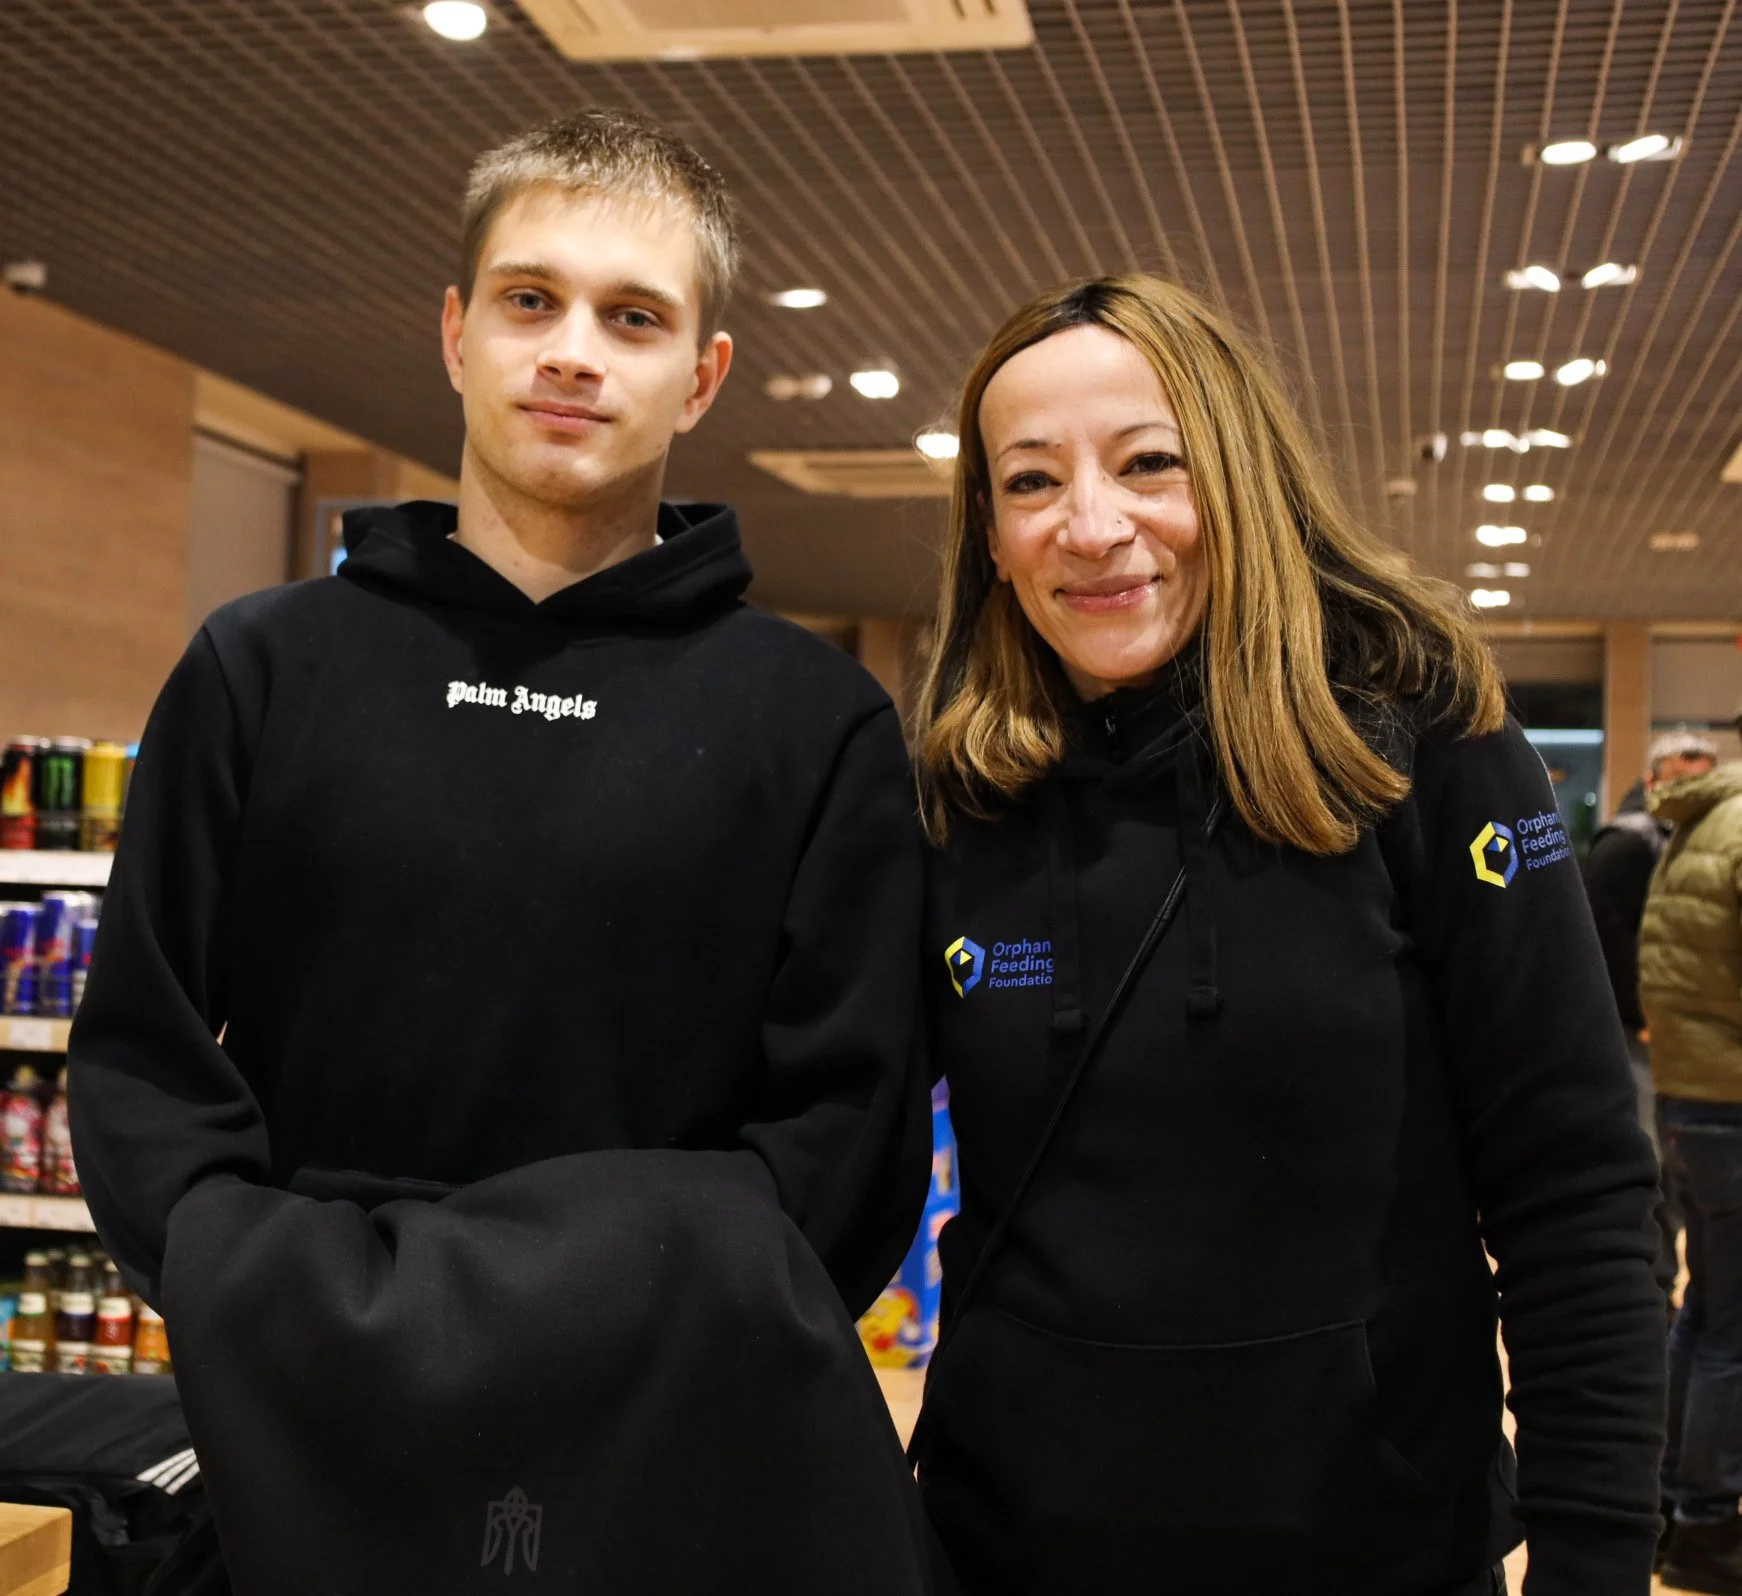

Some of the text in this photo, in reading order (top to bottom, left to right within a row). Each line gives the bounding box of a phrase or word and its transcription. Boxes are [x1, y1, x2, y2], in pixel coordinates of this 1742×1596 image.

[446, 680, 598, 722] Palm Angels
[992, 937, 1052, 958] Orphan
[988, 972, 1053, 988] Foundatio
